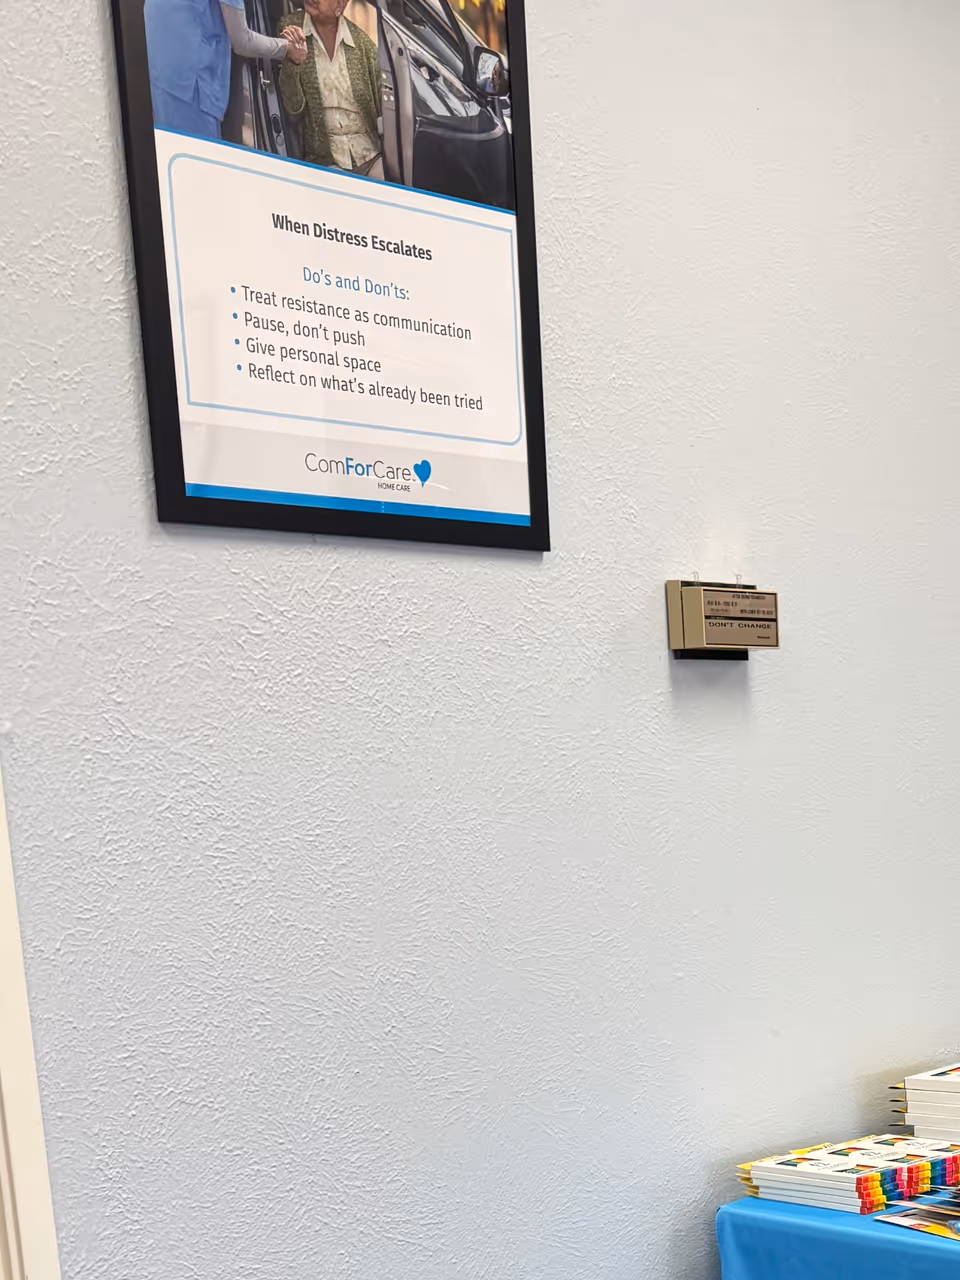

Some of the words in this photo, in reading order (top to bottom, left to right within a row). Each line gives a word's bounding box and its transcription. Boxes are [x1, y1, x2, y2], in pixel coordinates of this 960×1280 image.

[272, 213, 310, 236] When
[313, 223, 368, 248] Distress
[371, 235, 433, 261] Escalates
[303, 266, 332, 285] Do's
[336, 276, 360, 291] and
[365, 278, 410, 300] Don'ts:
[241, 285, 278, 306] Treat
[282, 295, 350, 320] resistance
[354, 309, 369, 323] as
[373, 313, 472, 340] communication
[244, 311, 289, 336] Pause,
[293, 320, 329, 341] don't
[333, 330, 366, 346] push
[246, 337, 275, 356] Give
[280, 345, 340, 366] personal
[343, 356, 381, 373] space
[248, 363, 296, 384] Reflect
[300, 374, 316, 387] on
[320, 375, 365, 394] what's
[368, 381, 416, 404] already
[420, 387, 450, 406] been
[454, 395, 483, 411] tried
[304, 452, 412, 481] ComForCare
[377, 482, 395, 491] HOME
[396, 483, 411, 492] CARE
